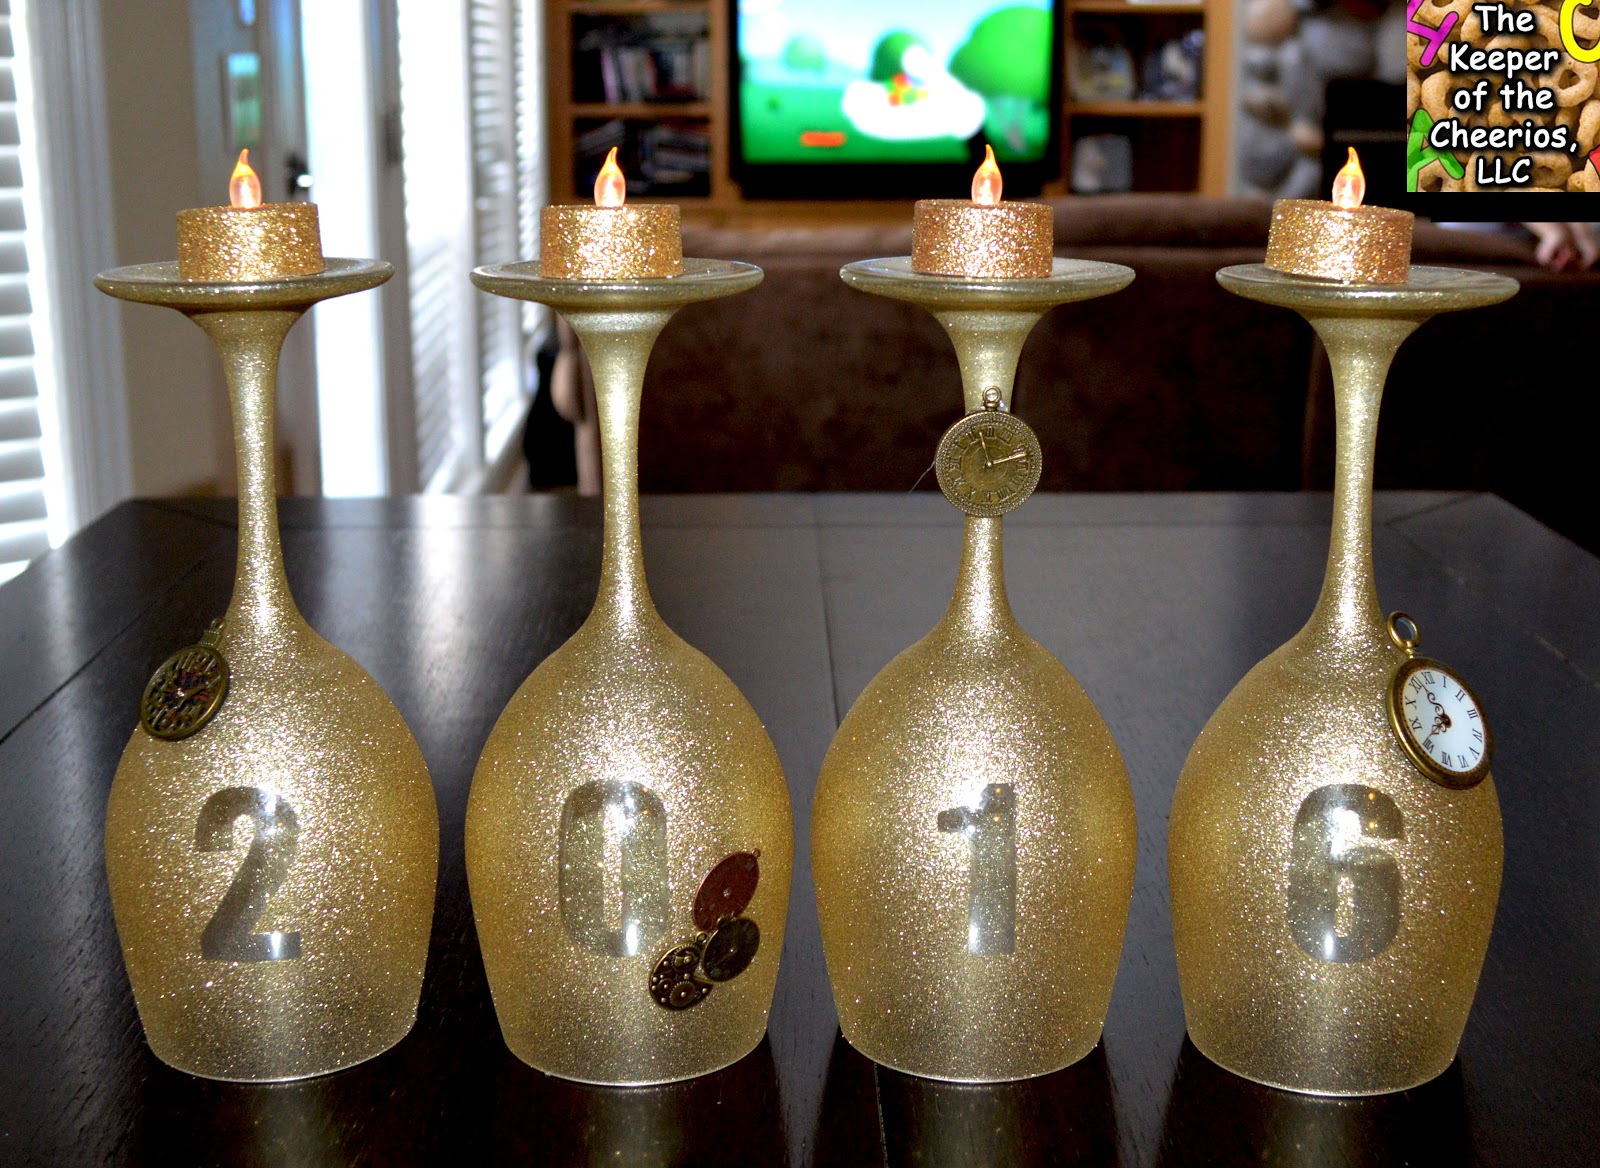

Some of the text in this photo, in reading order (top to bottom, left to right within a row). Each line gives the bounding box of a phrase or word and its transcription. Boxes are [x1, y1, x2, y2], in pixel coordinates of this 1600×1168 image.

[1405, 696, 1417, 709] X
[1455, 689, 1466, 703] II
[1466, 709, 1479, 720] III
[1408, 717, 1423, 733] IX
[1469, 746, 1480, 760] V
[196, 779, 1401, 963] 2 0 1 6
